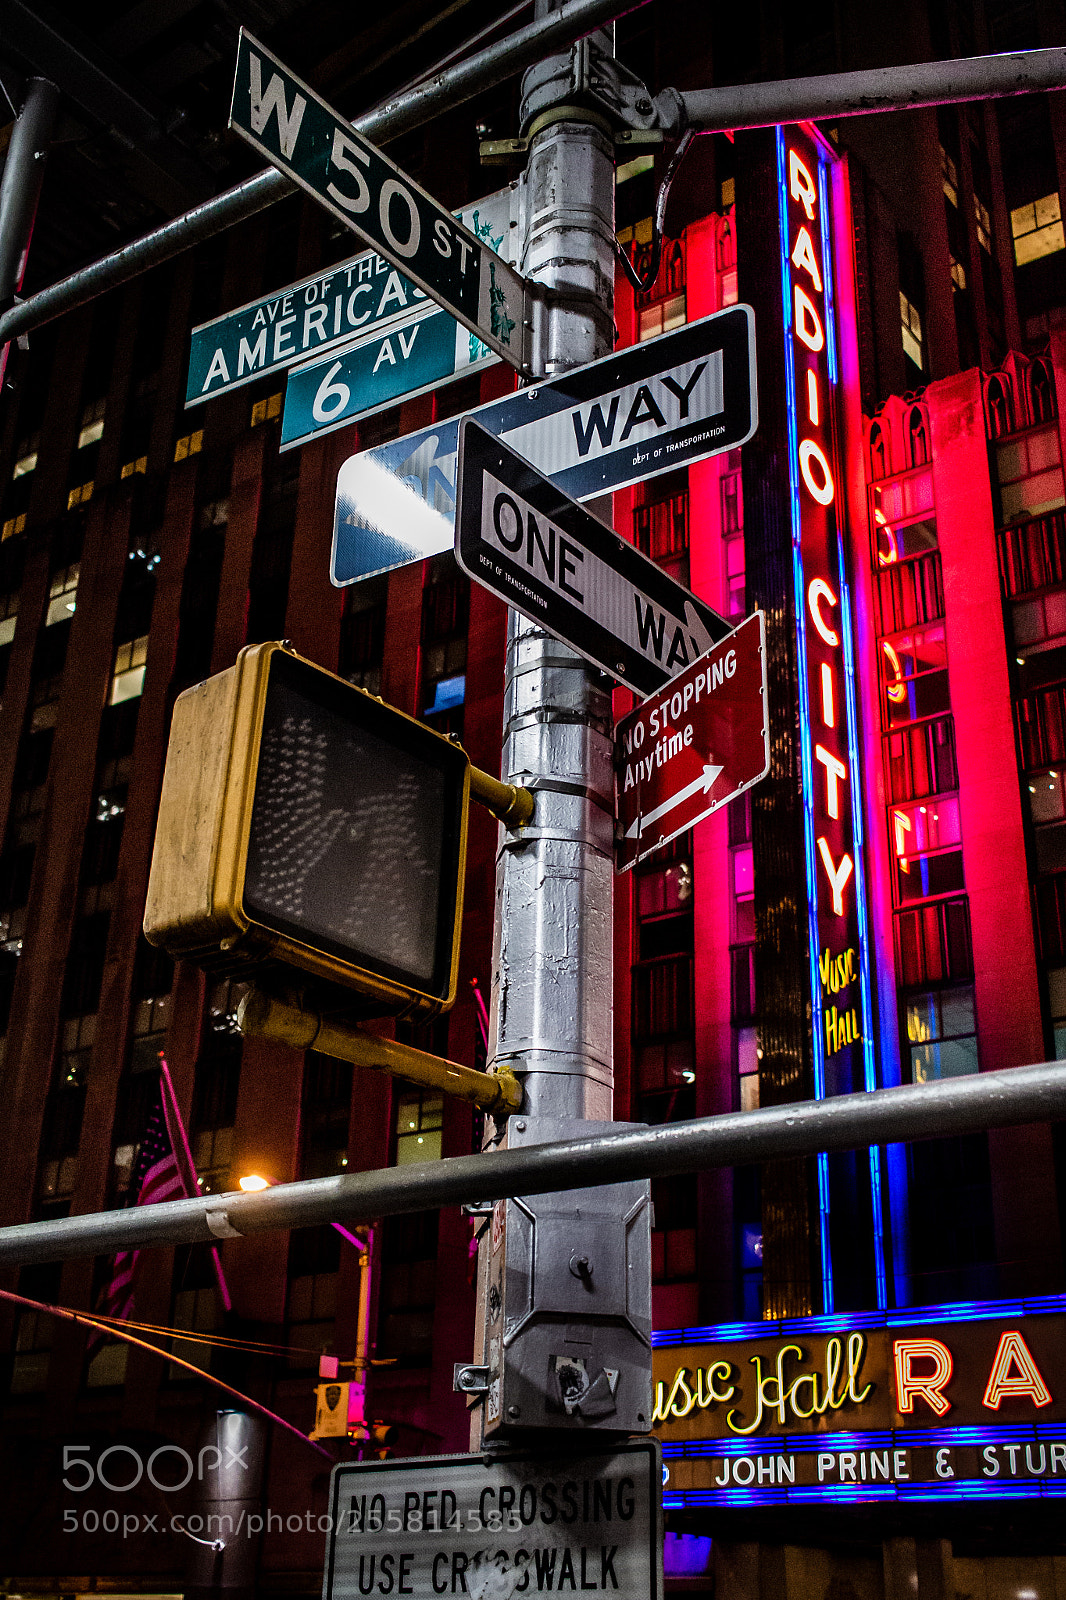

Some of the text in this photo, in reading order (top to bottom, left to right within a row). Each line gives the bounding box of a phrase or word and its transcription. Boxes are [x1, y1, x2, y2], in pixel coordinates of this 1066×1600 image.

[249, 51, 473, 274] W 50 ST
[201, 270, 427, 393] AMERICA
[251, 255, 389, 331] AVE OF THE
[312, 324, 420, 423] 6 AV
[571, 361, 709, 457] WAY
[632, 425, 726, 466] DEPT OF TRANSPORTATION
[493, 491, 584, 605] ONE
[789, 149, 854, 917] RADIO CITY
[622, 649, 737, 758] NO STOPPING
[623, 724, 694, 793] Anytime
[727, 1331, 871, 1435] Hall
[350, 1493, 386, 1534] NO
[479, 1477, 635, 1528] CROSSING
[715, 1455, 796, 1487] JOHN
[817, 1449, 910, 1482] PRINE
[935, 1448, 955, 1478] &
[358, 1545, 619, 1596] USE CRSWALK
